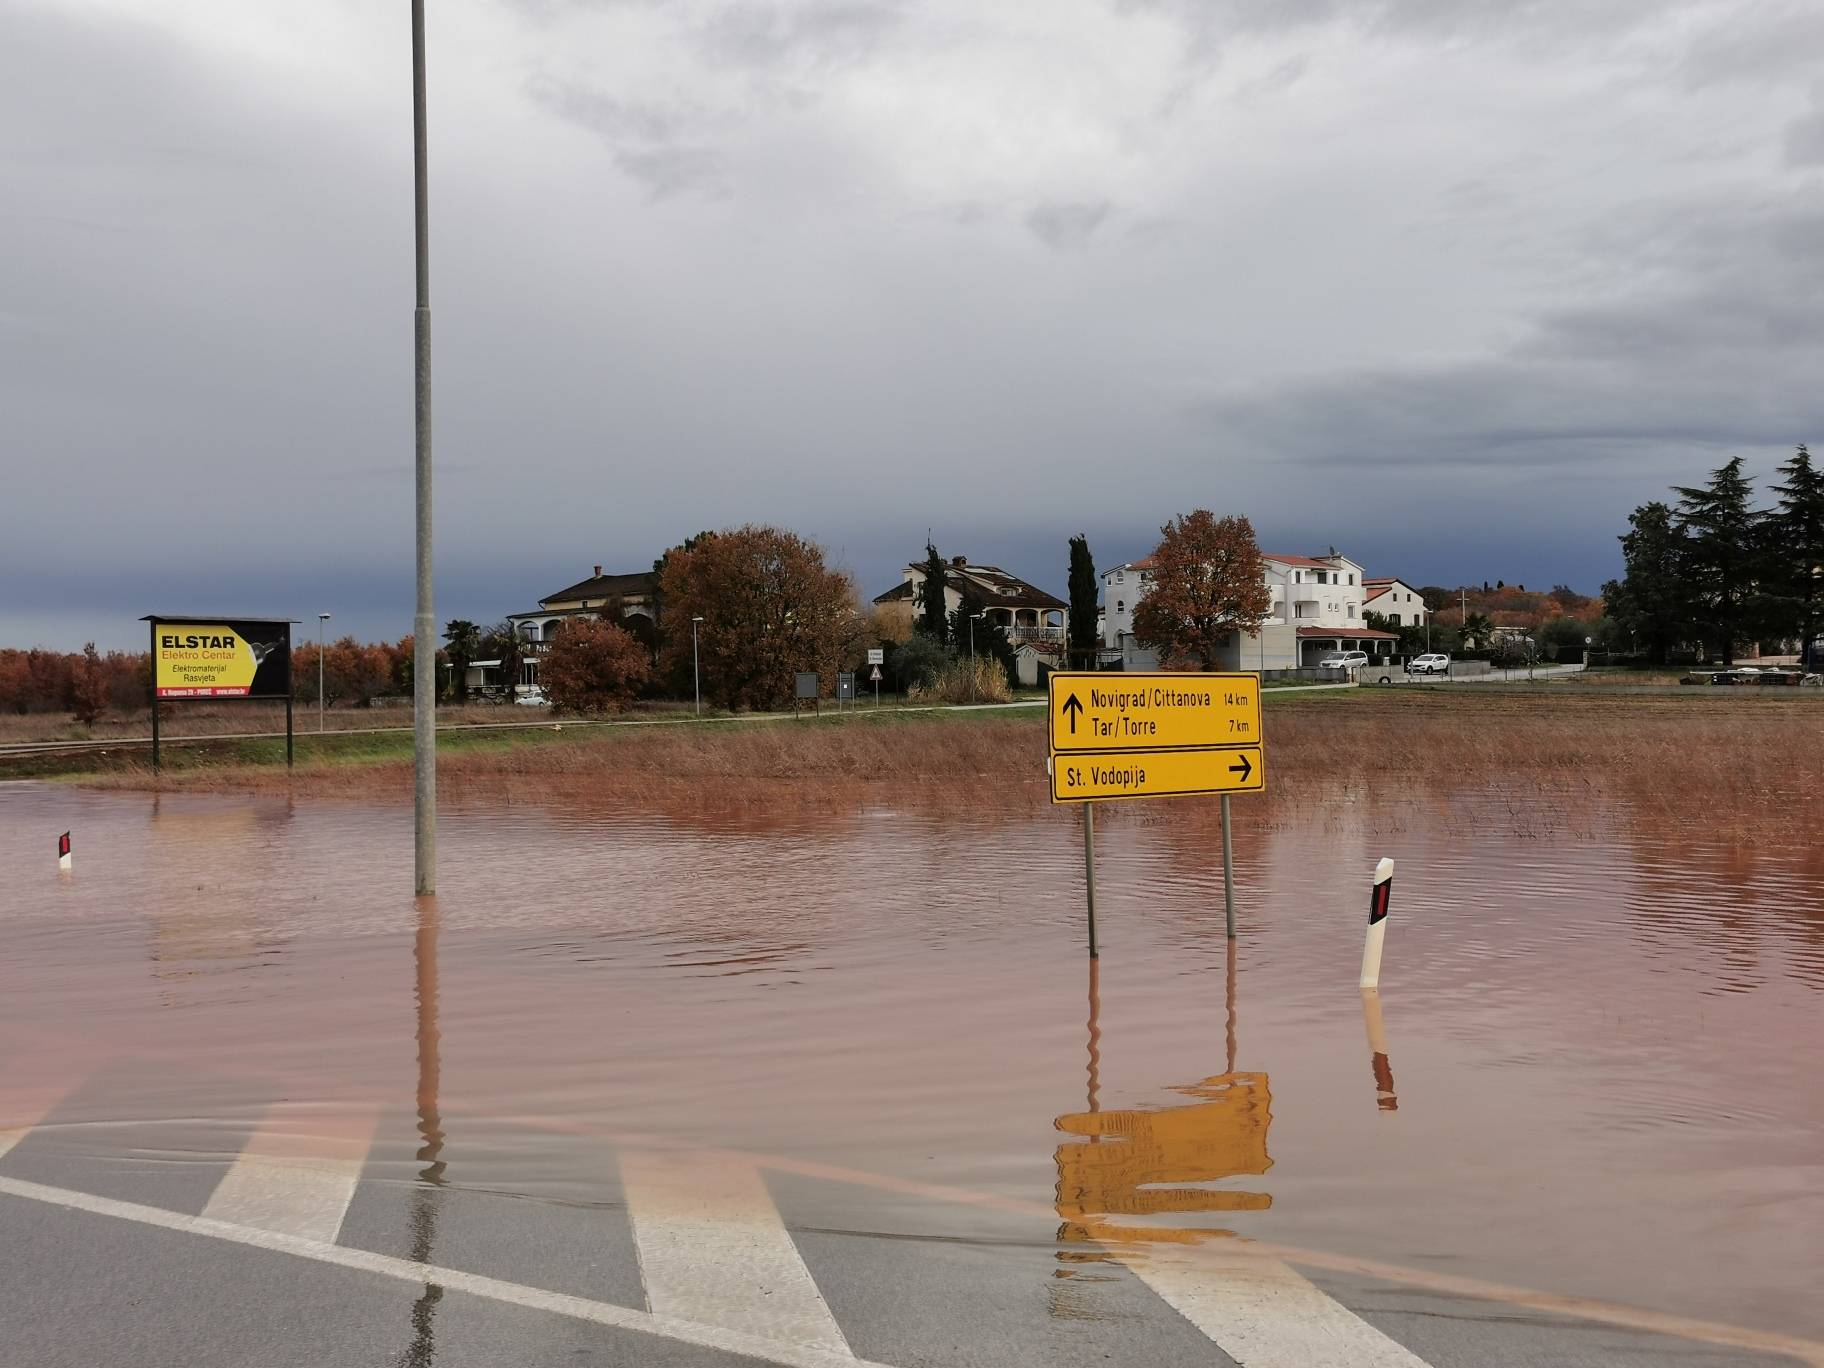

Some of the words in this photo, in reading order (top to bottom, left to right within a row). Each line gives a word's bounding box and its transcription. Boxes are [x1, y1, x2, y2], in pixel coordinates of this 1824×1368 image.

[162, 635, 235, 648] ELSTAR
[162, 650, 199, 660] Elektro
[201, 650, 236, 660] Centar
[183, 673, 216, 684] Rasvjeta
[1091, 688, 1211, 712] Novigrad/Cittanova
[1224, 693, 1234, 706] 14
[1235, 693, 1248, 706] km
[1092, 716, 1157, 738] Tar/Torre
[1229, 720, 1235, 732] 7
[1237, 719, 1249, 732] km
[1067, 767, 1086, 787] St.
[1091, 765, 1146, 789] Vodopija
